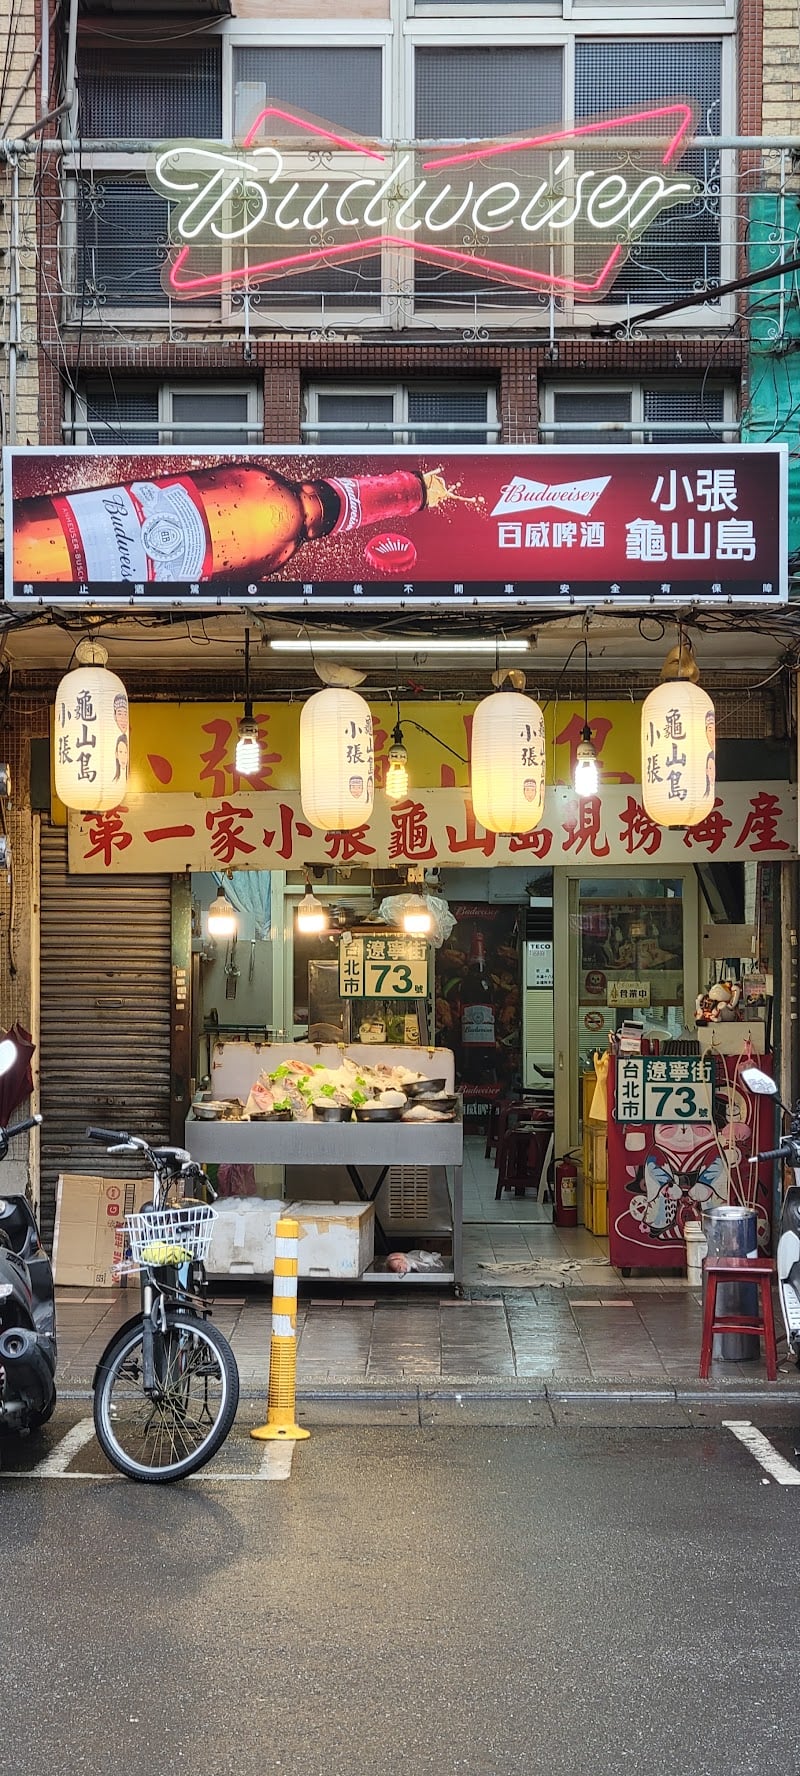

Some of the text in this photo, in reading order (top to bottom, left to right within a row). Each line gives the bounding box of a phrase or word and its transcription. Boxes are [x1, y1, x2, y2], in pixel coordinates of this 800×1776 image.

[156, 147, 691, 238] Budweiser
[500, 484, 601, 503] Budweiser
[650, 469, 738, 512] 小張
[497, 521, 605, 548] 百威啤酒
[625, 517, 756, 561] 龜山島
[59, 702, 74, 764] 小張
[74, 689, 97, 783] 龜山島
[345, 720, 365, 764] 小張
[520, 724, 539, 767] 小張
[646, 721, 664, 784] 小張
[663, 708, 688, 801] 龜山島
[344, 941, 360, 994] 台北市
[366, 940, 427, 961] 遼寧街
[622, 1061, 640, 1118] 台北市
[646, 1060, 712, 1082] 遼寧街
